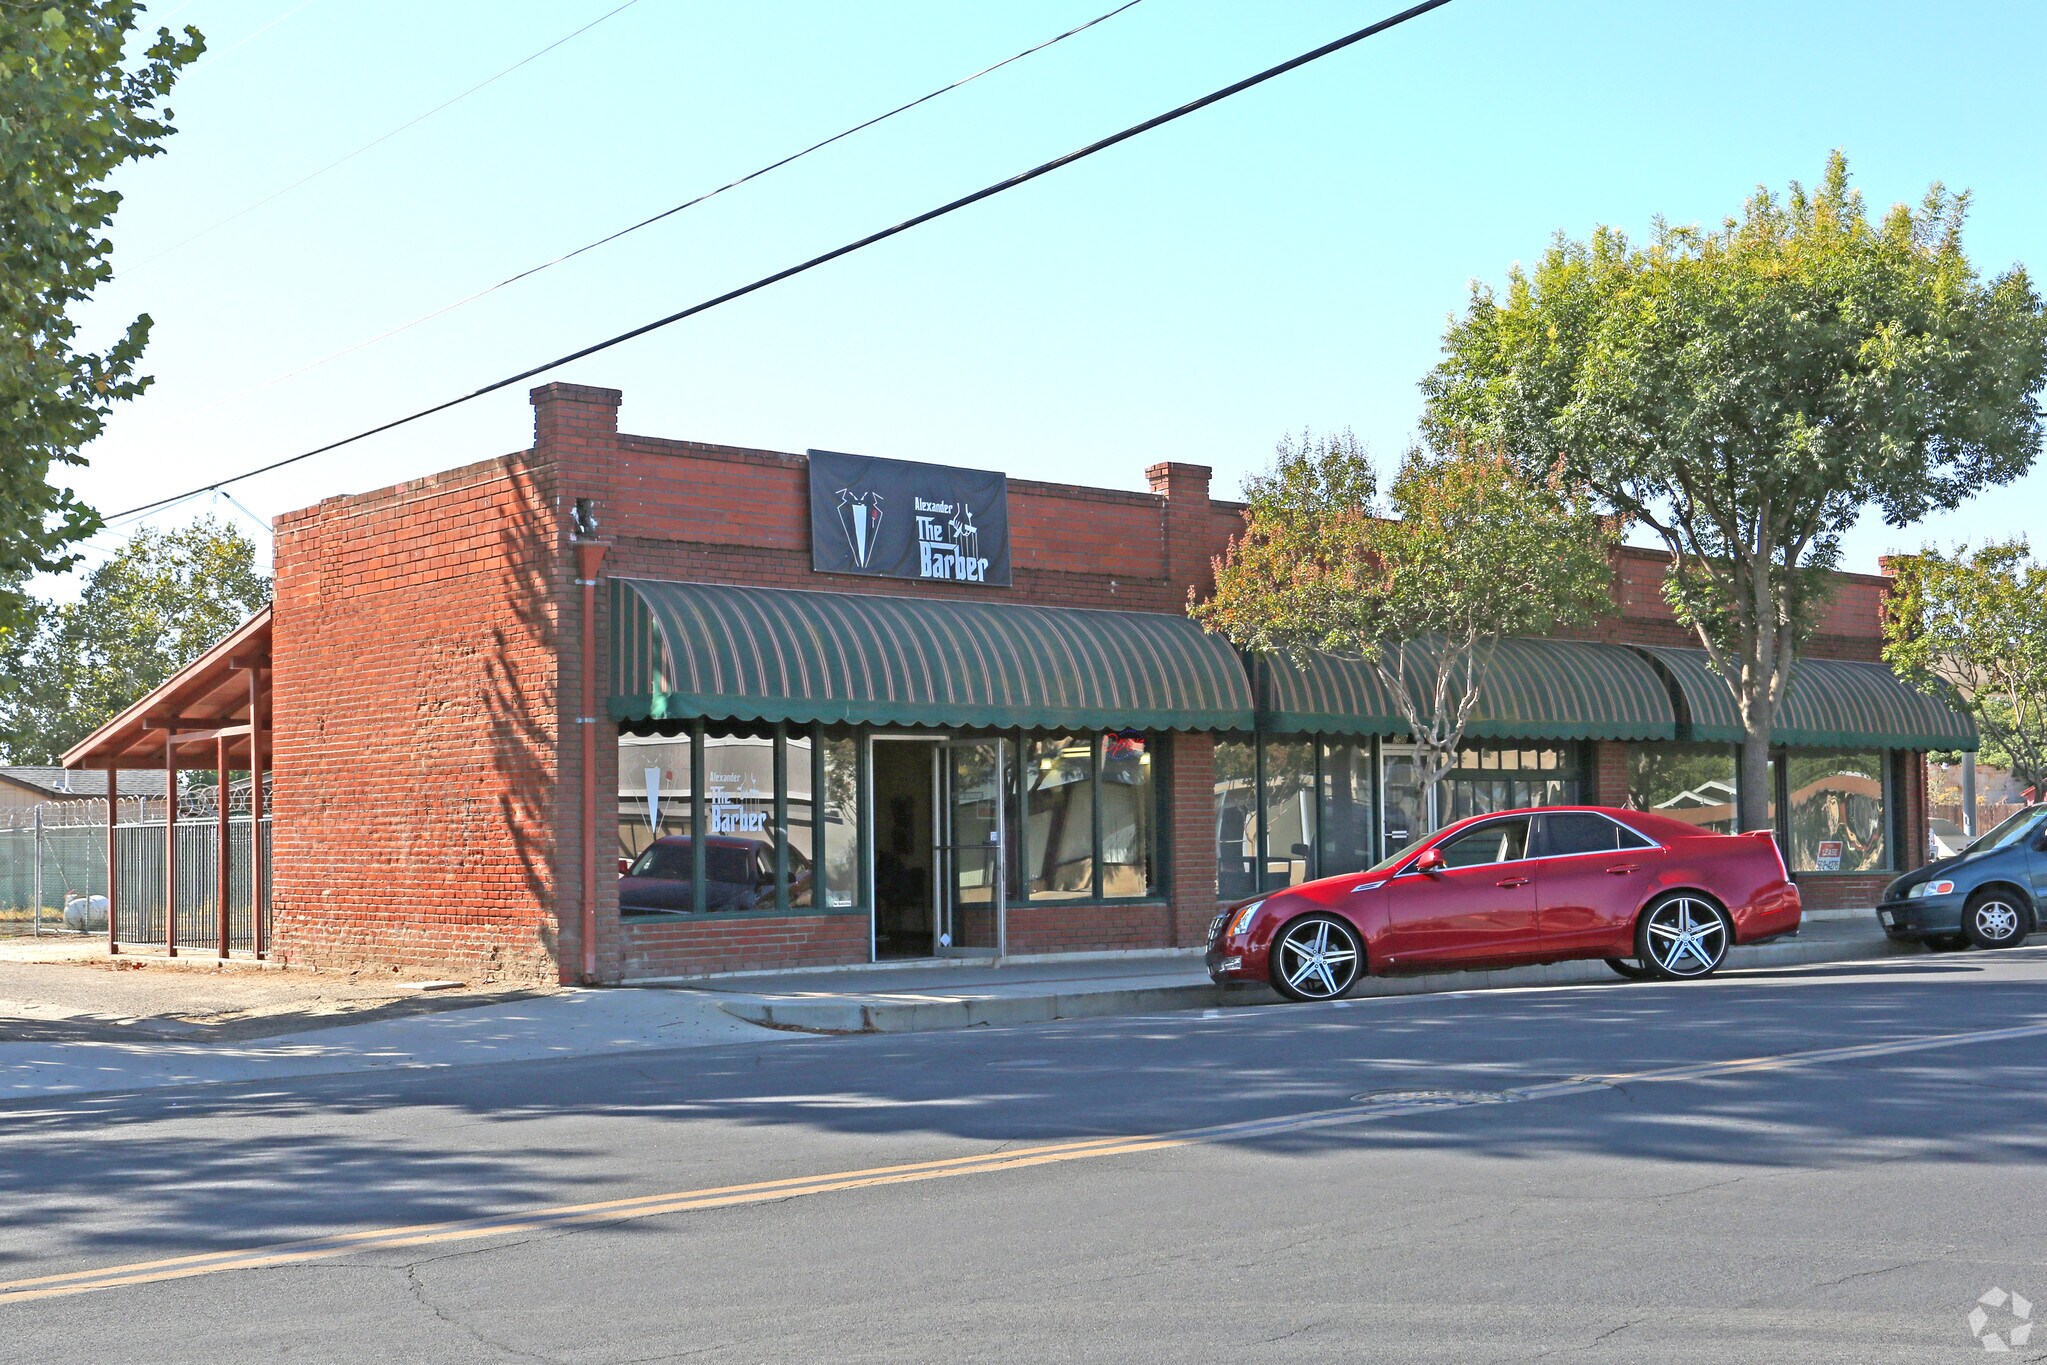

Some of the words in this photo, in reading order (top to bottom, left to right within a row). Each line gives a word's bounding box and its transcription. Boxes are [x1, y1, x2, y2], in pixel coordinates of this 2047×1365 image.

[914, 496, 953, 514] Alexander
[915, 515, 943, 541] The
[919, 541, 989, 582] Barber
[709, 771, 741, 782] Alexander
[710, 785, 732, 804] The
[711, 804, 767, 832] Barber
[1821, 848, 1839, 856] LEASE
